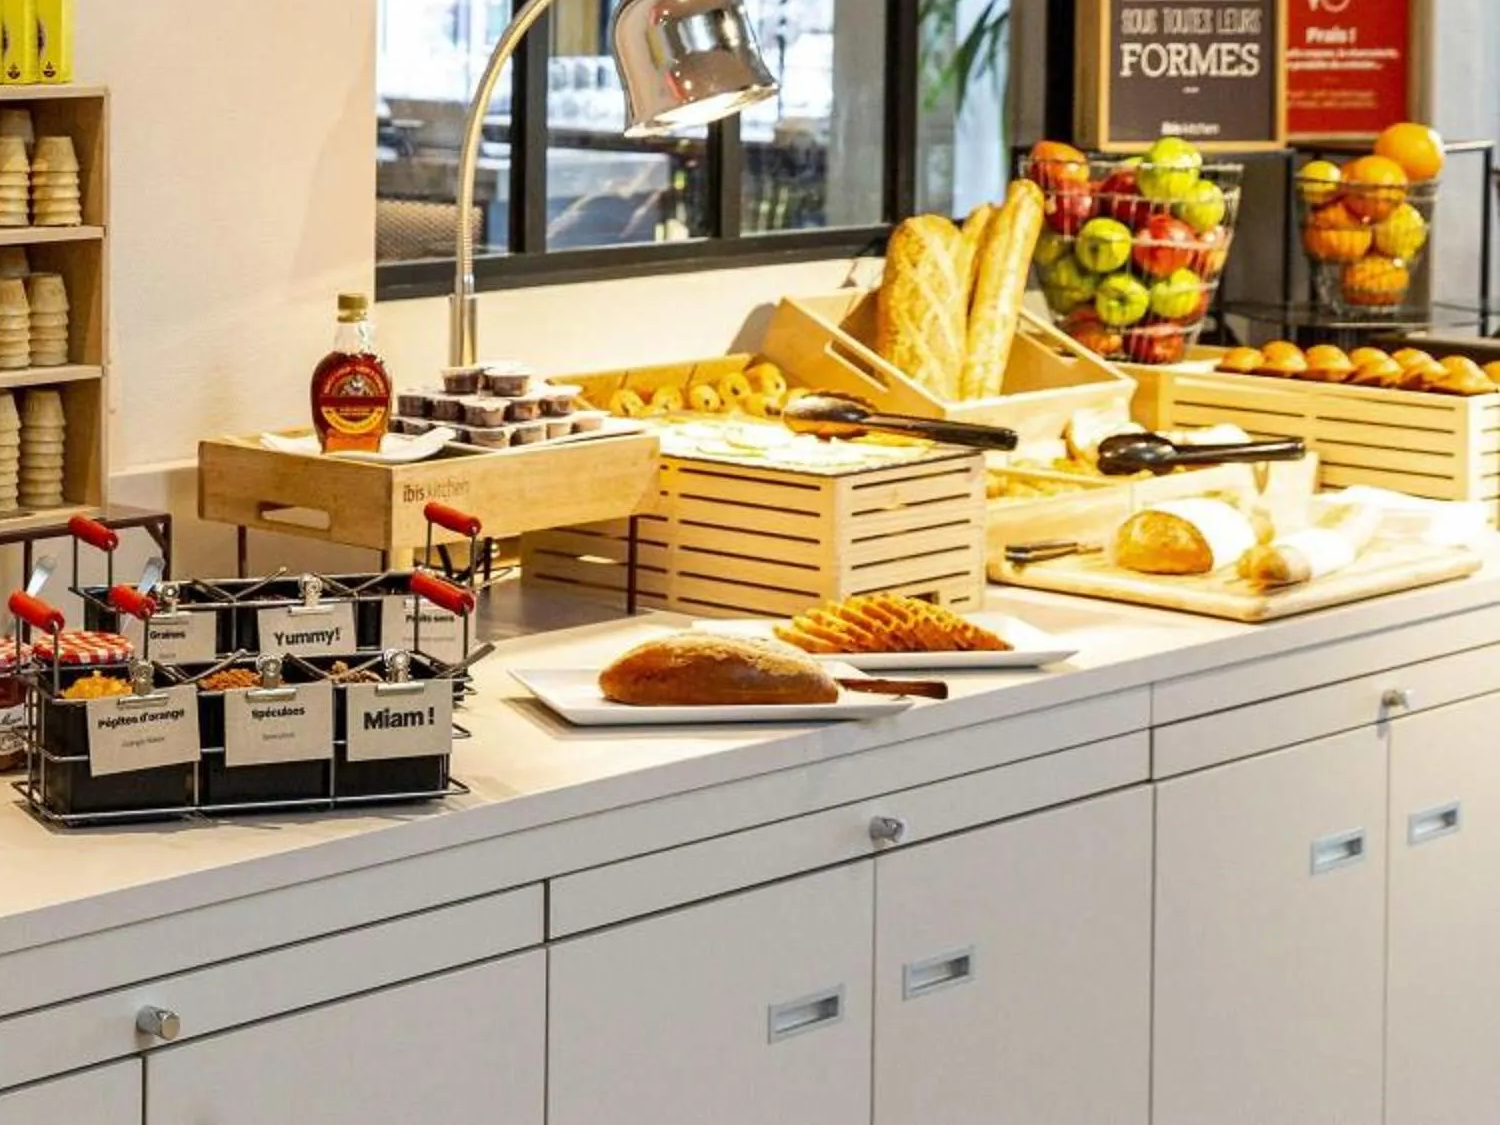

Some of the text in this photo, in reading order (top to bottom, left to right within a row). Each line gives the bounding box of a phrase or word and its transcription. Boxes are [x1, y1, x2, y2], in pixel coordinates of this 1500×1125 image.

[1120, 42, 1261, 77] FORMES
[403, 483, 425, 503] ibis
[273, 626, 340, 647] Yummy!
[363, 707, 425, 730] Miam
